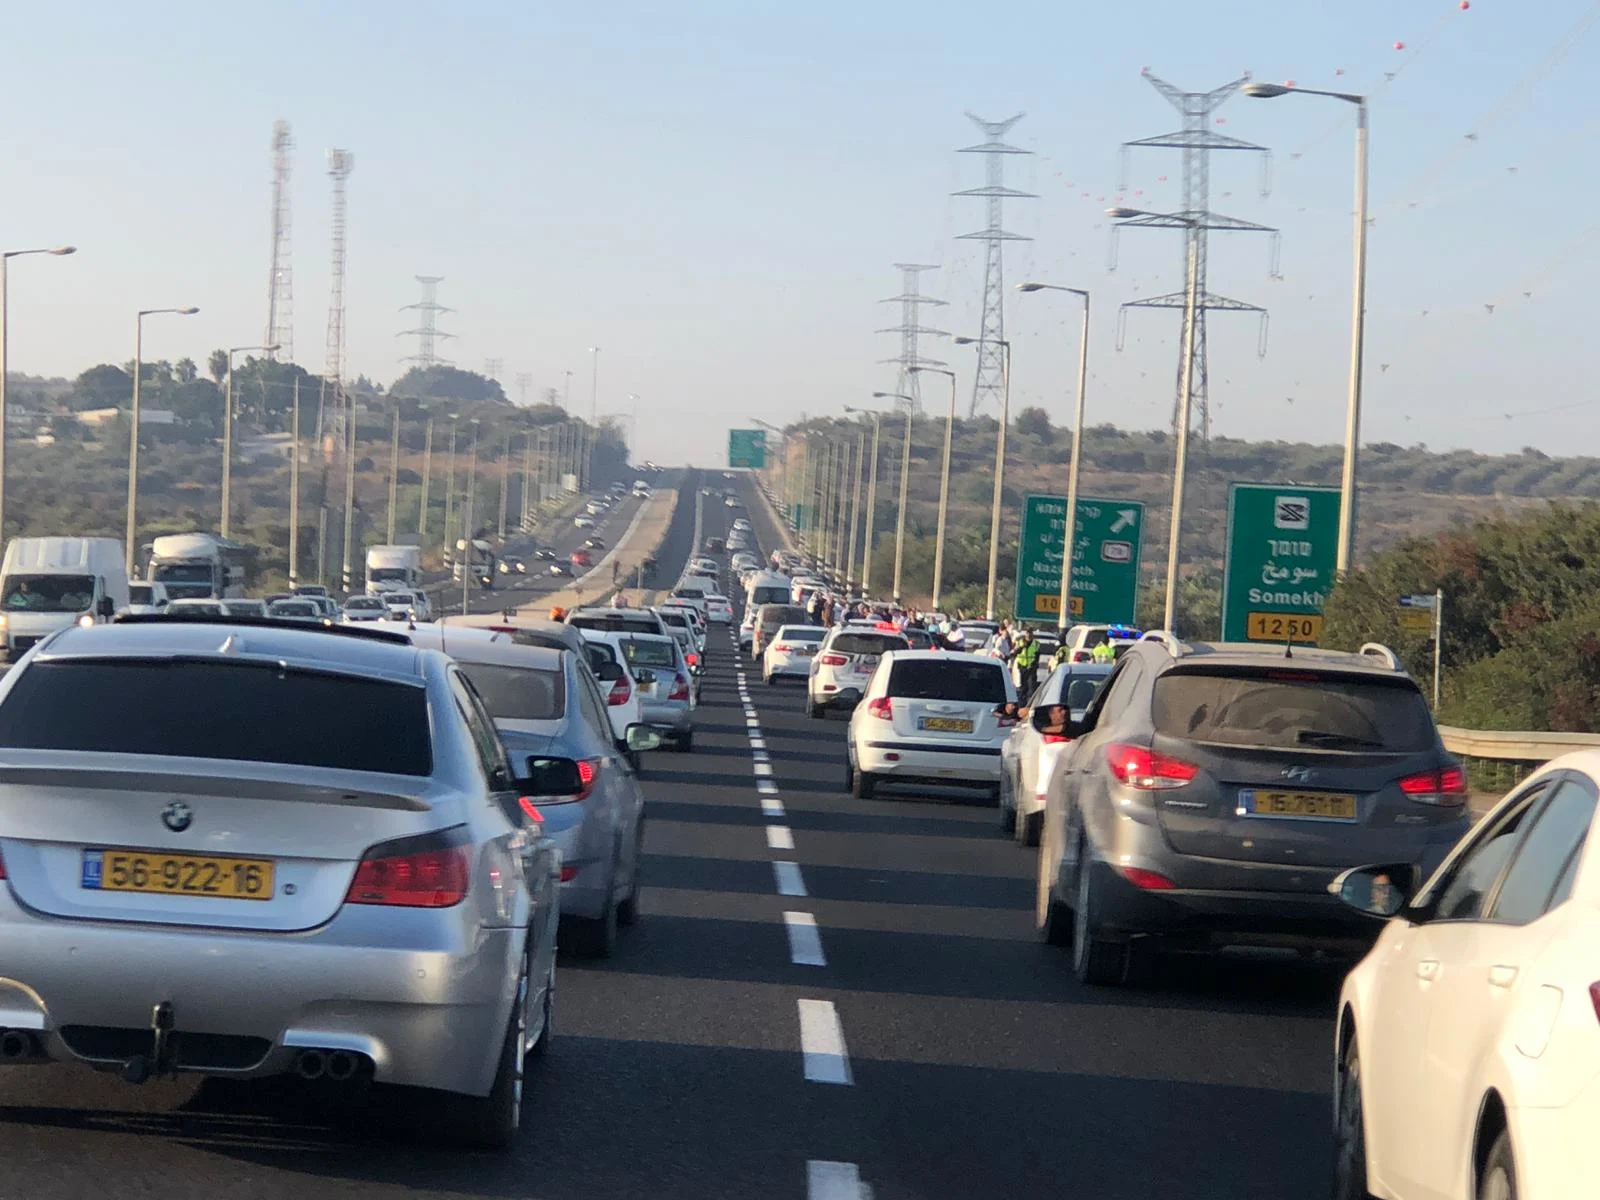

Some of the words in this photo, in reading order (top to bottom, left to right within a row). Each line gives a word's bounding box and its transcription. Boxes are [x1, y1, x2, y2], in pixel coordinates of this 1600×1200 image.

[1267, 539, 1312, 557] סומך
[1033, 561, 1095, 576] Nazeth
[1042, 598, 1077, 611] 100
[1248, 588, 1325, 605] Somekh
[1257, 618, 1313, 637] 1250
[111, 856, 264, 894] 56-922-16
